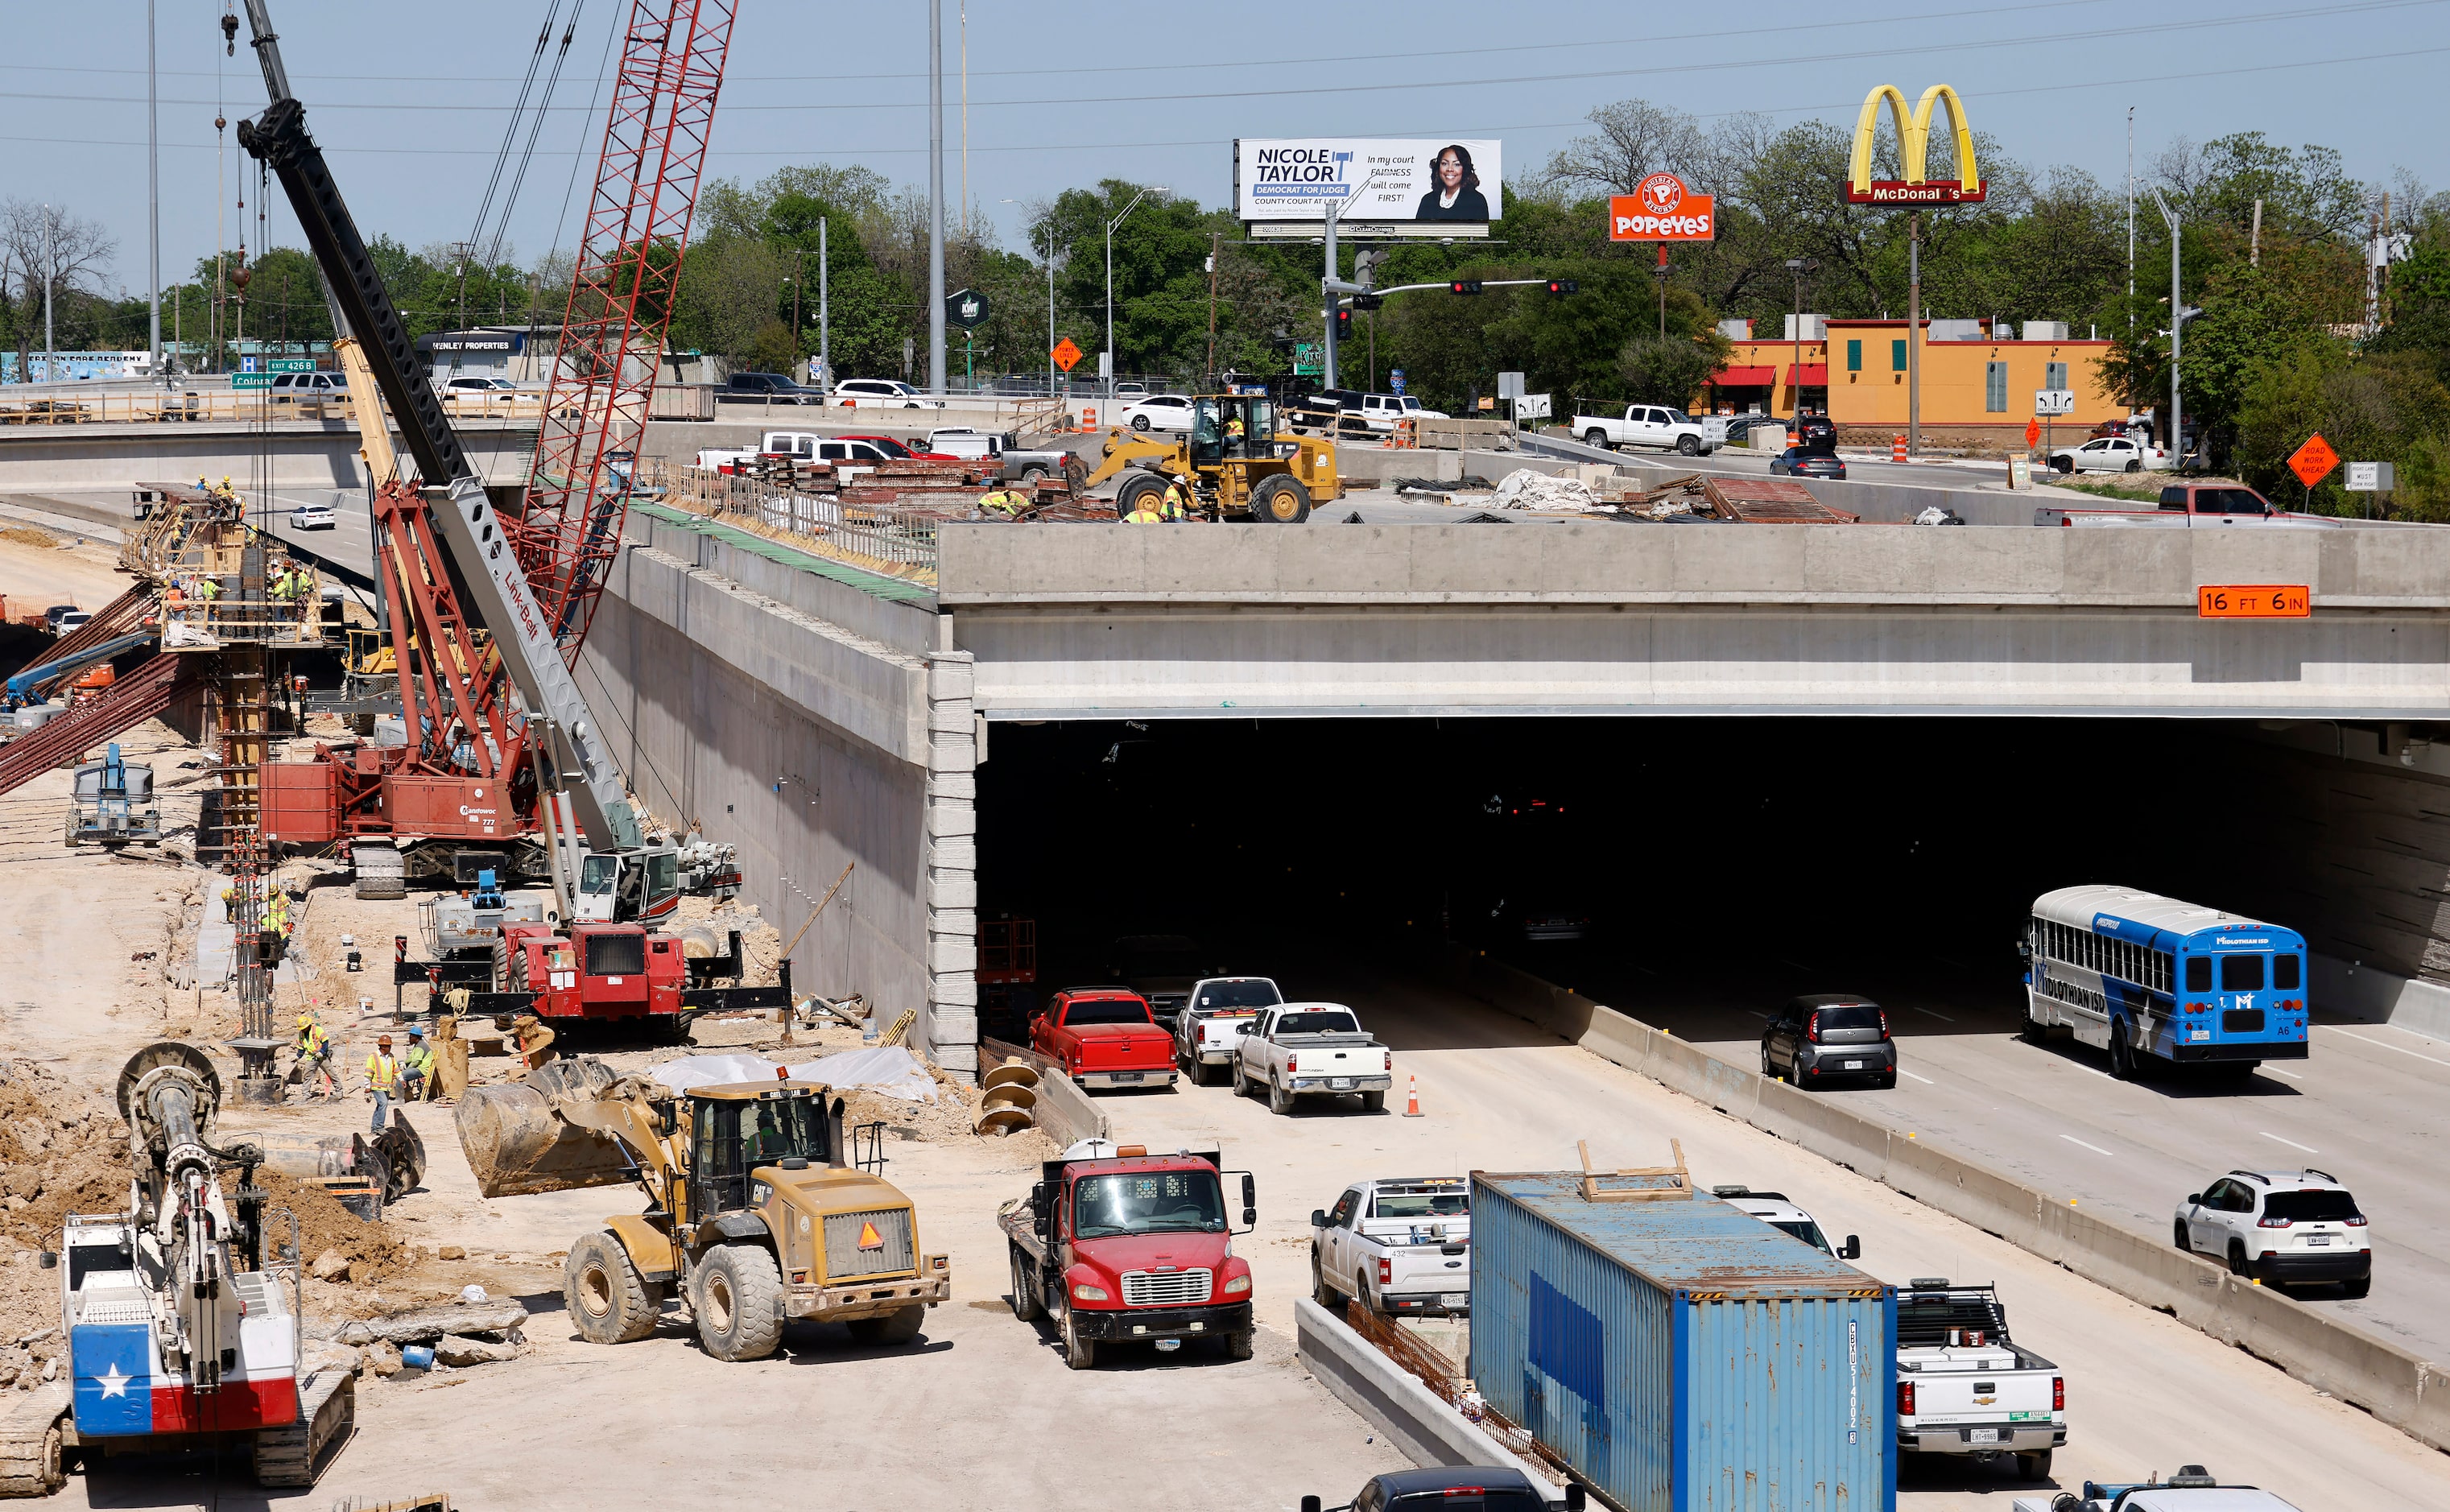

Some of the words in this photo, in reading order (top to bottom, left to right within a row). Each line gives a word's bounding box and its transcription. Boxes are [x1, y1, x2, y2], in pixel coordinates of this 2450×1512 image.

[1258, 149, 1329, 163] NICOLE
[1367, 155, 1375, 163] In
[1377, 157, 1390, 166] my
[1392, 155, 1415, 163] court
[1257, 165, 1334, 182] TAYLOR
[1319, 186, 1345, 195] JUDGE
[1370, 180, 1386, 189] will
[1644, 177, 1679, 192] LOUISIANA
[1378, 194, 1404, 202] FIRST!
[1646, 199, 1677, 213] KITCHEN
[432, 341, 463, 349] HENLEY
[465, 341, 509, 349] PROPERTIES
[242, 357, 254, 372] H
[1274, 444, 1283, 456] AT
[505, 570, 538, 642] Link-Belt
[2206, 593, 2228, 610] 16
[2240, 598, 2258, 610] FT
[2272, 593, 2286, 609] 6
[2289, 598, 2303, 609] IN
[460, 805, 496, 816] Manitowoc
[2217, 936, 2258, 945] MIDLOTHIAN
[2035, 959, 2090, 1009] MIDLOTHIAN
[2090, 990, 2105, 1014] ISD
[2277, 1027, 2290, 1035] A6
[754, 1184, 766, 1202] CAT
[1850, 1433, 1856, 1444] 3
